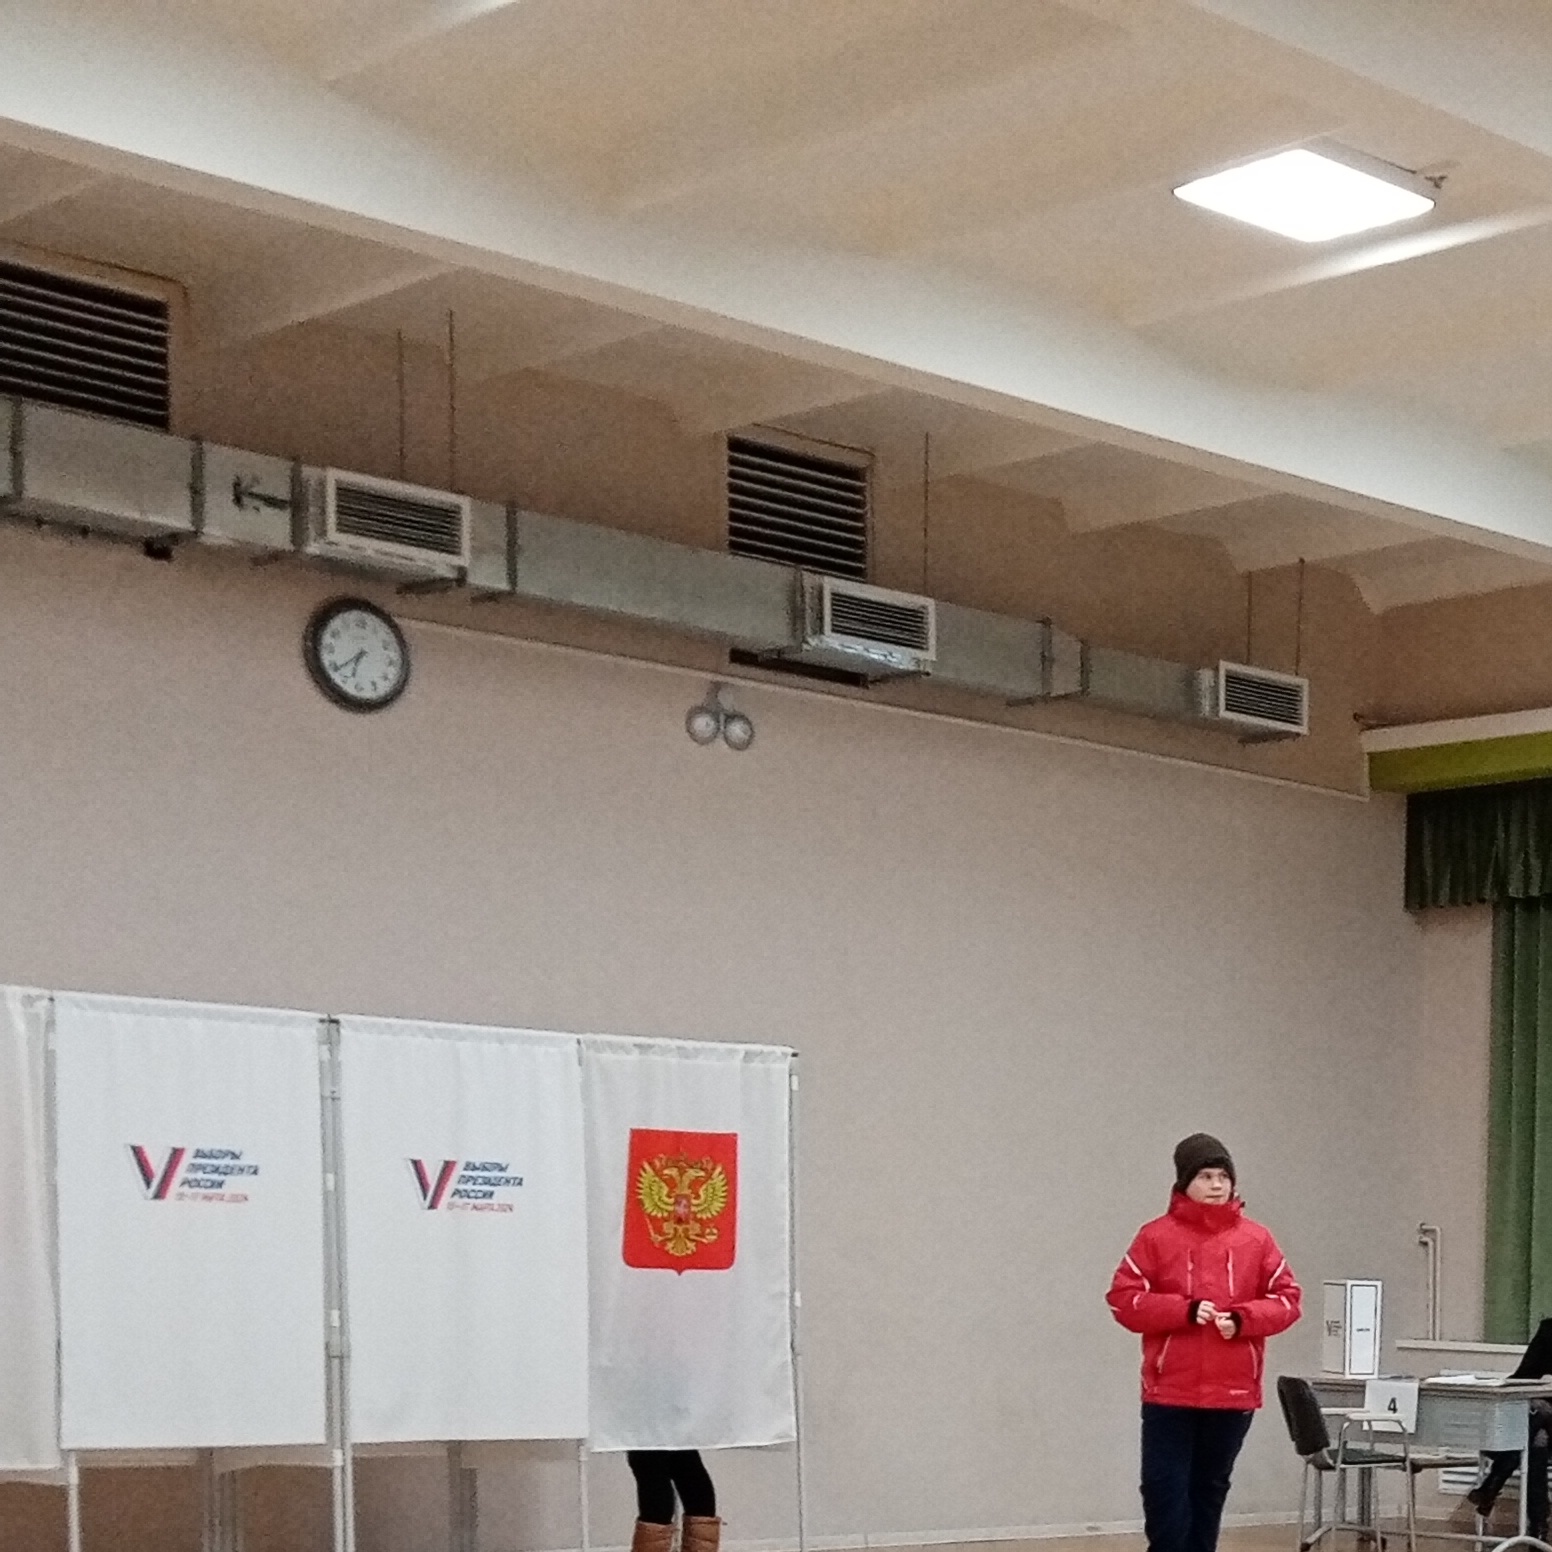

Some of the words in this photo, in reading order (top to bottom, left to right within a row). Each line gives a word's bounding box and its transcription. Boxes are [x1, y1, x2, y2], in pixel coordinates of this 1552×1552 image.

[463, 1161, 510, 1172] ВЫБОРЫ
[179, 1177, 225, 1189] РОССИИ
[457, 1174, 524, 1187] ПРЕЗИДЕНТА
[451, 1188, 495, 1199] РОССИИ
[1388, 1397, 1398, 1414] 4
